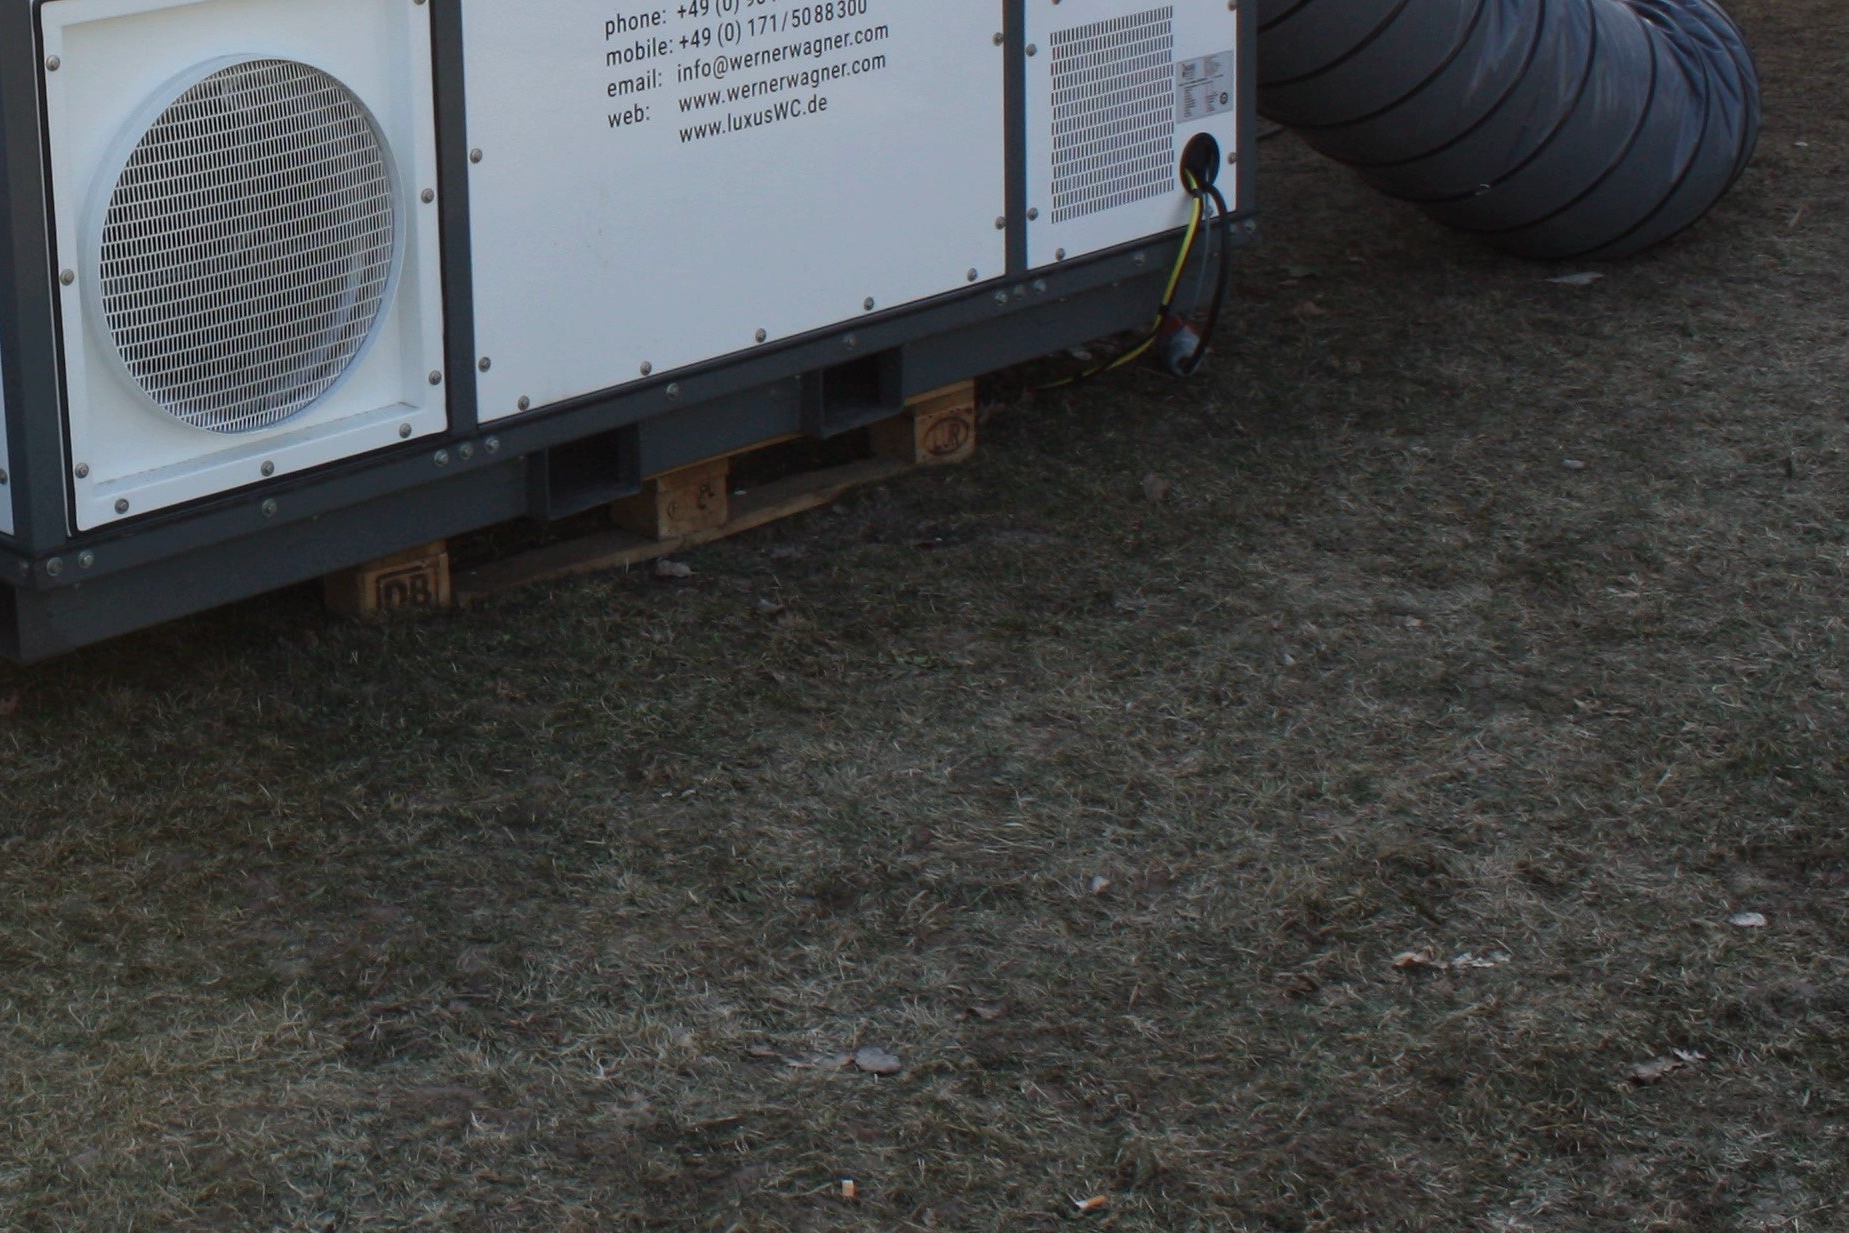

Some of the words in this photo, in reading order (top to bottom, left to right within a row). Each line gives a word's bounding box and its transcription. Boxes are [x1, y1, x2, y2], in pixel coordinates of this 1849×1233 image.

[605, 9, 667, 42] phone:
[606, 37, 673, 67] mobile:
[679, 27, 712, 50] +49
[717, 19, 742, 48] (0)
[607, 68, 662, 98] email:
[677, 24, 889, 83] info@wernerwagner.com
[607, 104, 650, 129] web:
[678, 54, 886, 113] www.wernerwagner.com
[679, 93, 828, 144] www.luxusWC.de
